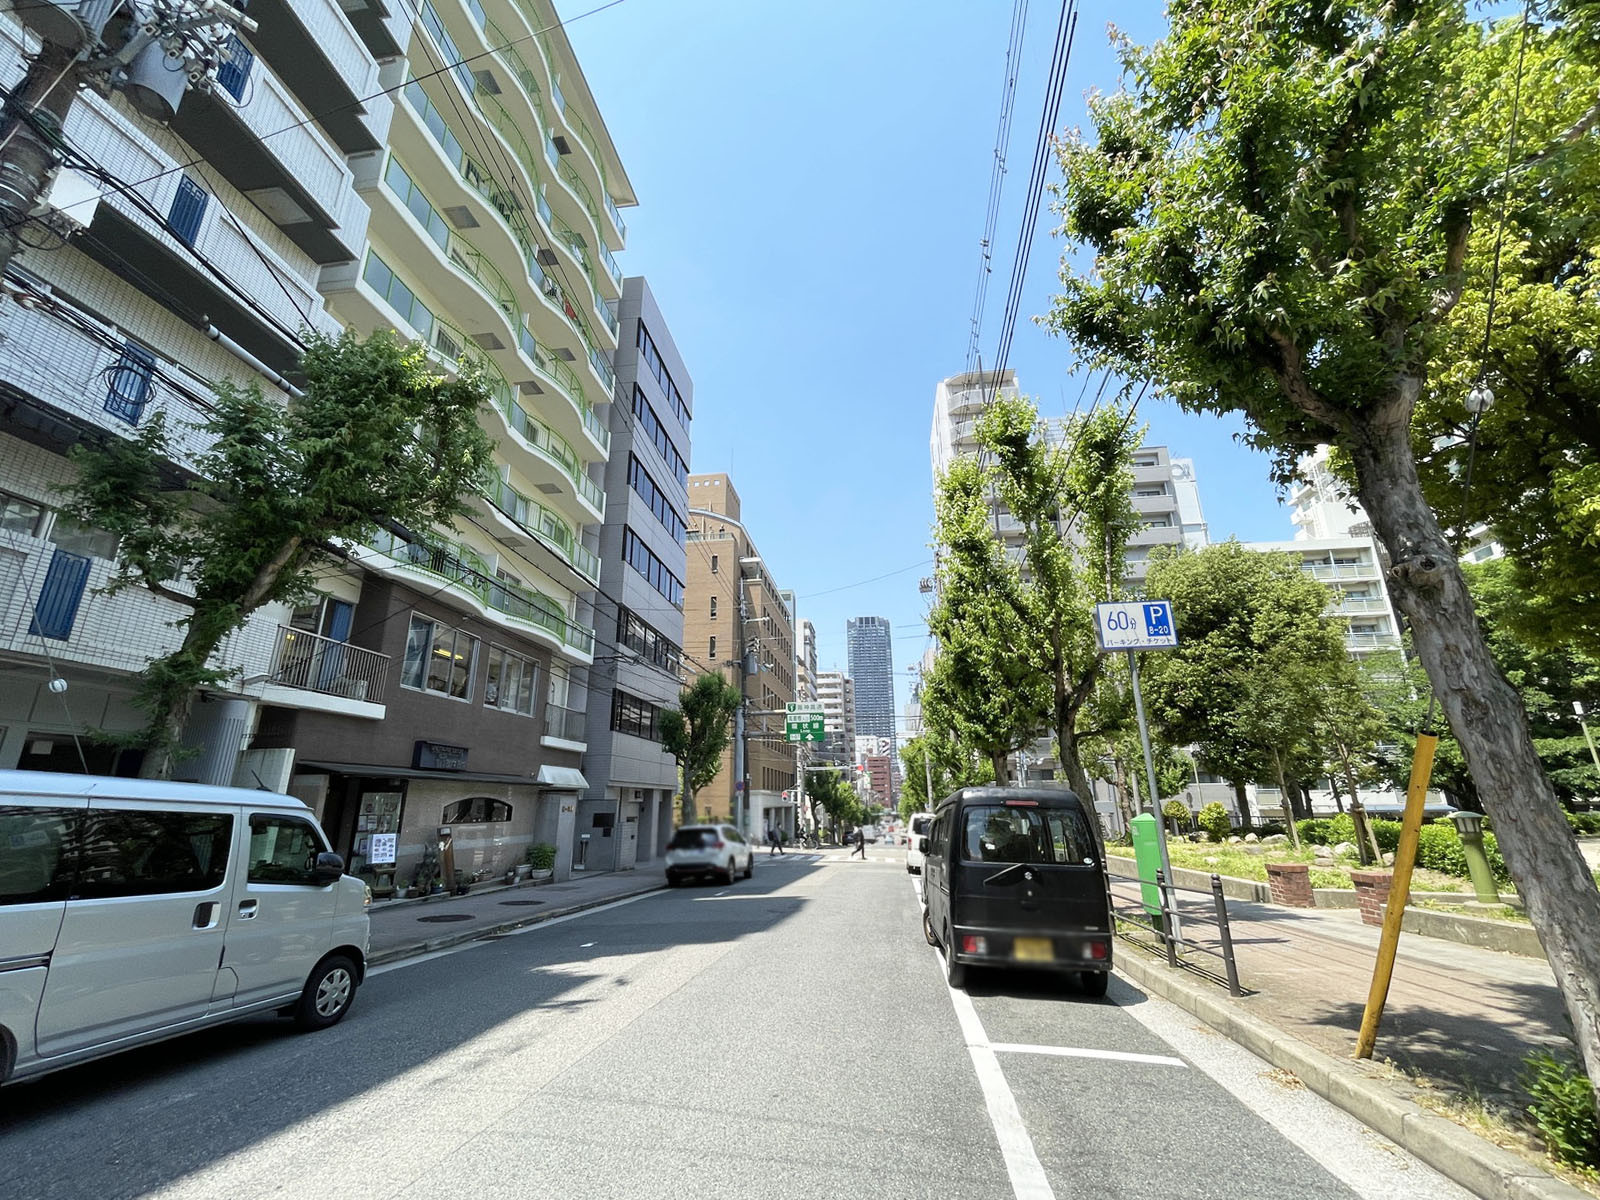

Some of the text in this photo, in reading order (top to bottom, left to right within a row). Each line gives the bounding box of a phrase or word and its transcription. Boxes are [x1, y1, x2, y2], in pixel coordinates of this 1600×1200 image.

[1107, 611, 1137, 631] 60分
[1150, 606, 1163, 625] P
[1148, 626, 1169, 634] 8-20
[1106, 638, 1174, 646] パーキング・チケット
